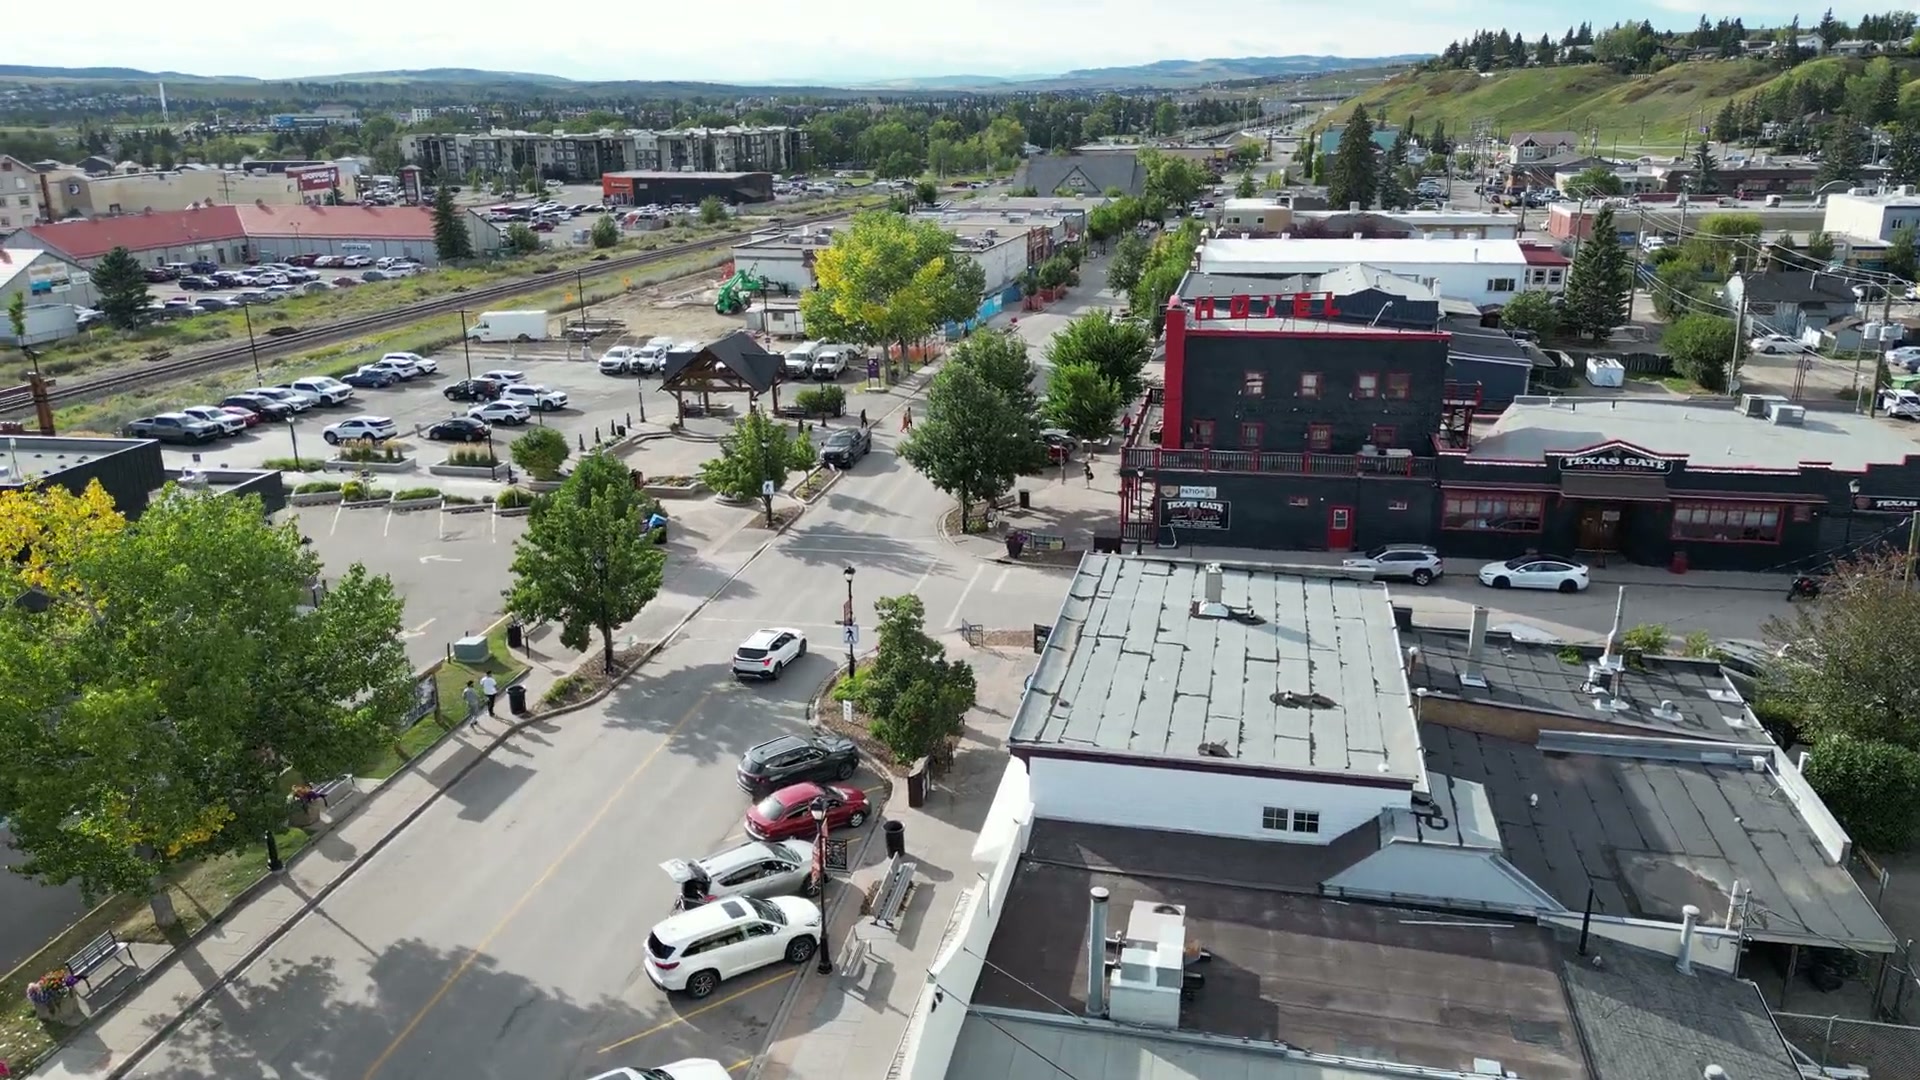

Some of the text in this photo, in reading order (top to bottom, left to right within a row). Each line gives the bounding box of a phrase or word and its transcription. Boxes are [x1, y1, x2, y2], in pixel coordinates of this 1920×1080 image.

[1195, 291, 1341, 320] HOTEL
[1566, 456, 1620, 467] TEXAS
[1623, 457, 1666, 470] GATE
[1200, 501, 1224, 512] GATE
[1876, 500, 1918, 508] TEXAS
